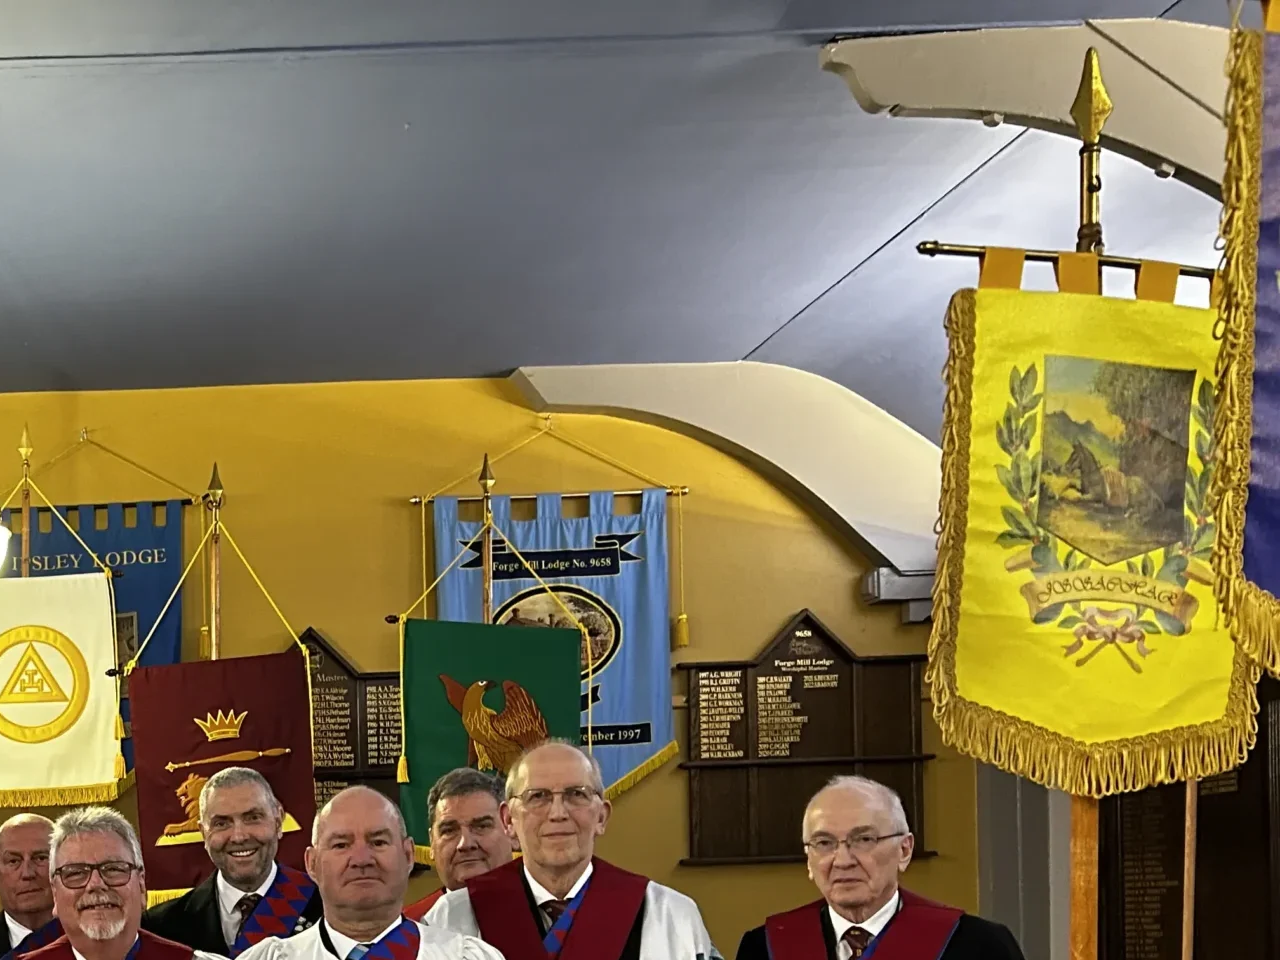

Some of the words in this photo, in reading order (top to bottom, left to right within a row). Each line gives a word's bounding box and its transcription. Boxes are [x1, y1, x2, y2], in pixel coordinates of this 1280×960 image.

[12, 553, 83, 571] ISLEY
[92, 548, 167, 568] LODGE
[493, 561, 519, 573] Forge
[541, 559, 570, 572] Lodge
[572, 558, 587, 569] No.
[590, 557, 611, 567] 9658
[774, 659, 795, 667] Forge
[812, 658, 834, 666] Lodge
[580, 730, 615, 741] ember
[618, 729, 641, 740] 1997
